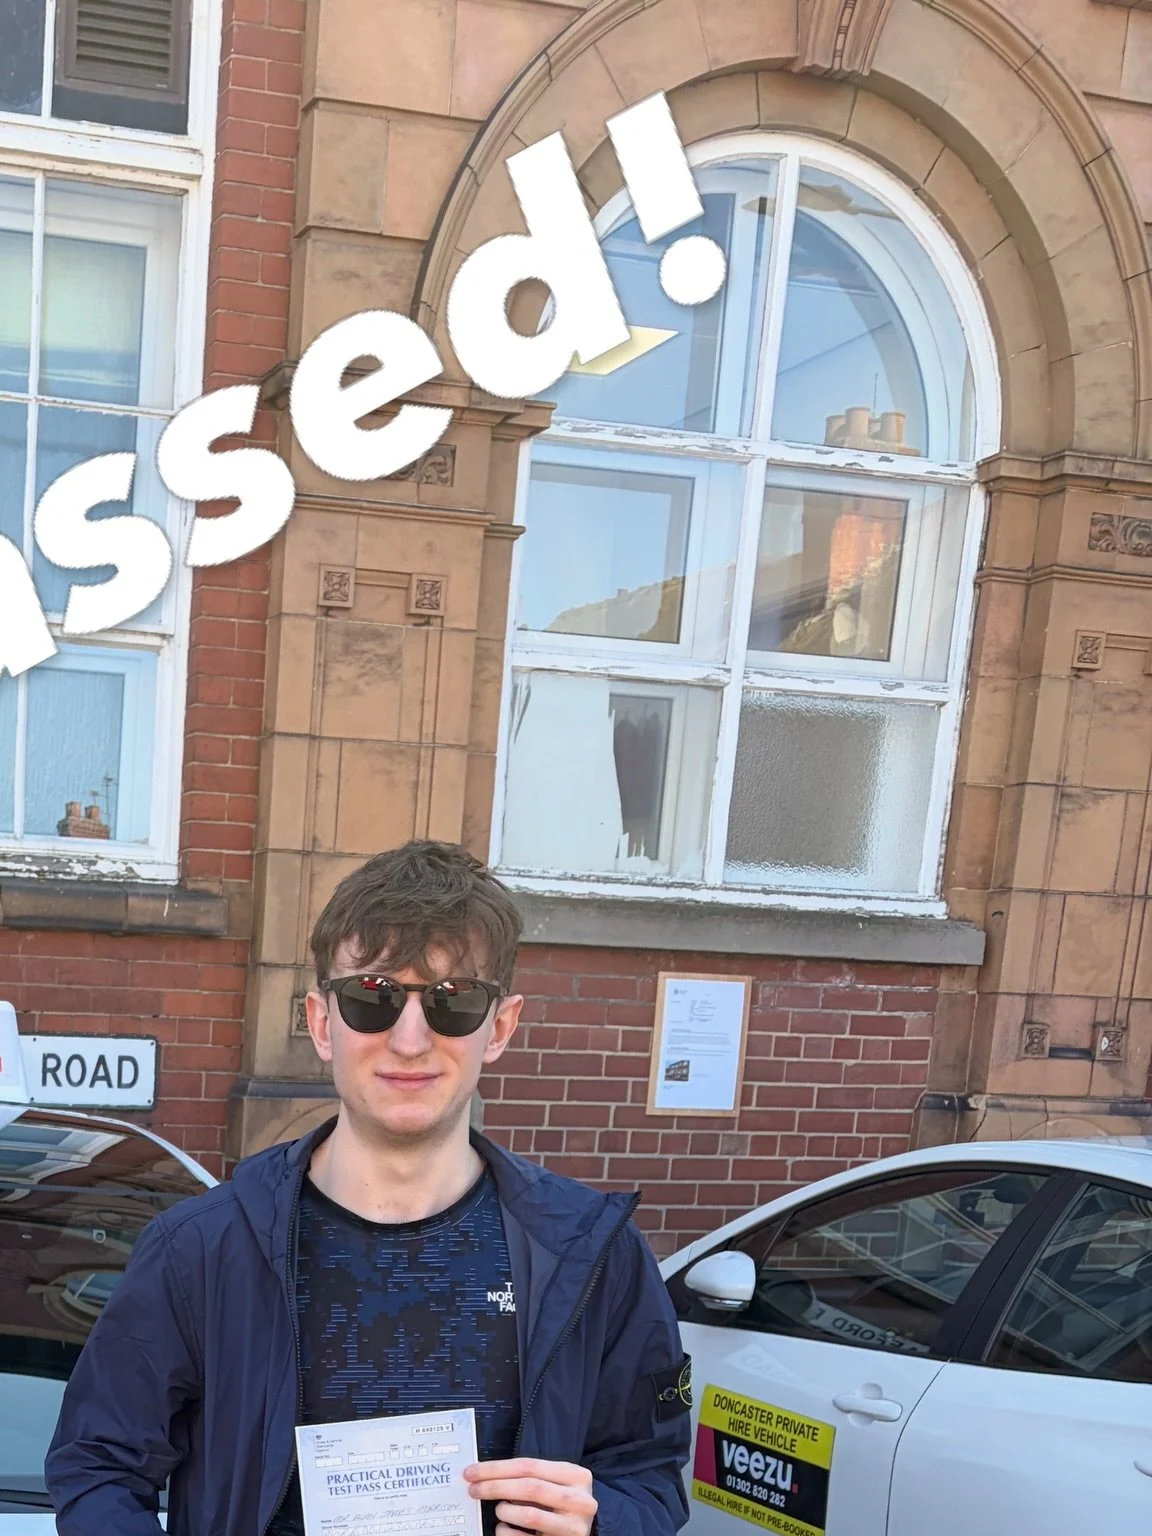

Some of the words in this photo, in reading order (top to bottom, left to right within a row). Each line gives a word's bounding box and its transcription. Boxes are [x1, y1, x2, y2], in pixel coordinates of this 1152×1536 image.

[41, 1052, 139, 1089] ROAD
[487, 1291, 515, 1302] NOR
[713, 1393, 774, 1426] DONCASTER
[776, 1414, 820, 1442] PRIVATE
[728, 1417, 752, 1437] HIRE
[754, 1425, 798, 1453] VEHICLE
[327, 1468, 393, 1485] PRACTICAL
[396, 1462, 451, 1478] DRIVING
[328, 1484, 353, 1497] TEST
[356, 1481, 382, 1494] PASS
[384, 1474, 451, 1491] CERTIFICATE
[698, 1487, 726, 1506] ILLEGAL
[726, 1499, 743, 1513] HIRE
[743, 1504, 751, 1514] IF
[751, 1508, 767, 1522] NOT
[726, 1474, 751, 1494] 01302
[752, 1484, 768, 1501] 820
[770, 1490, 786, 1508] 282
